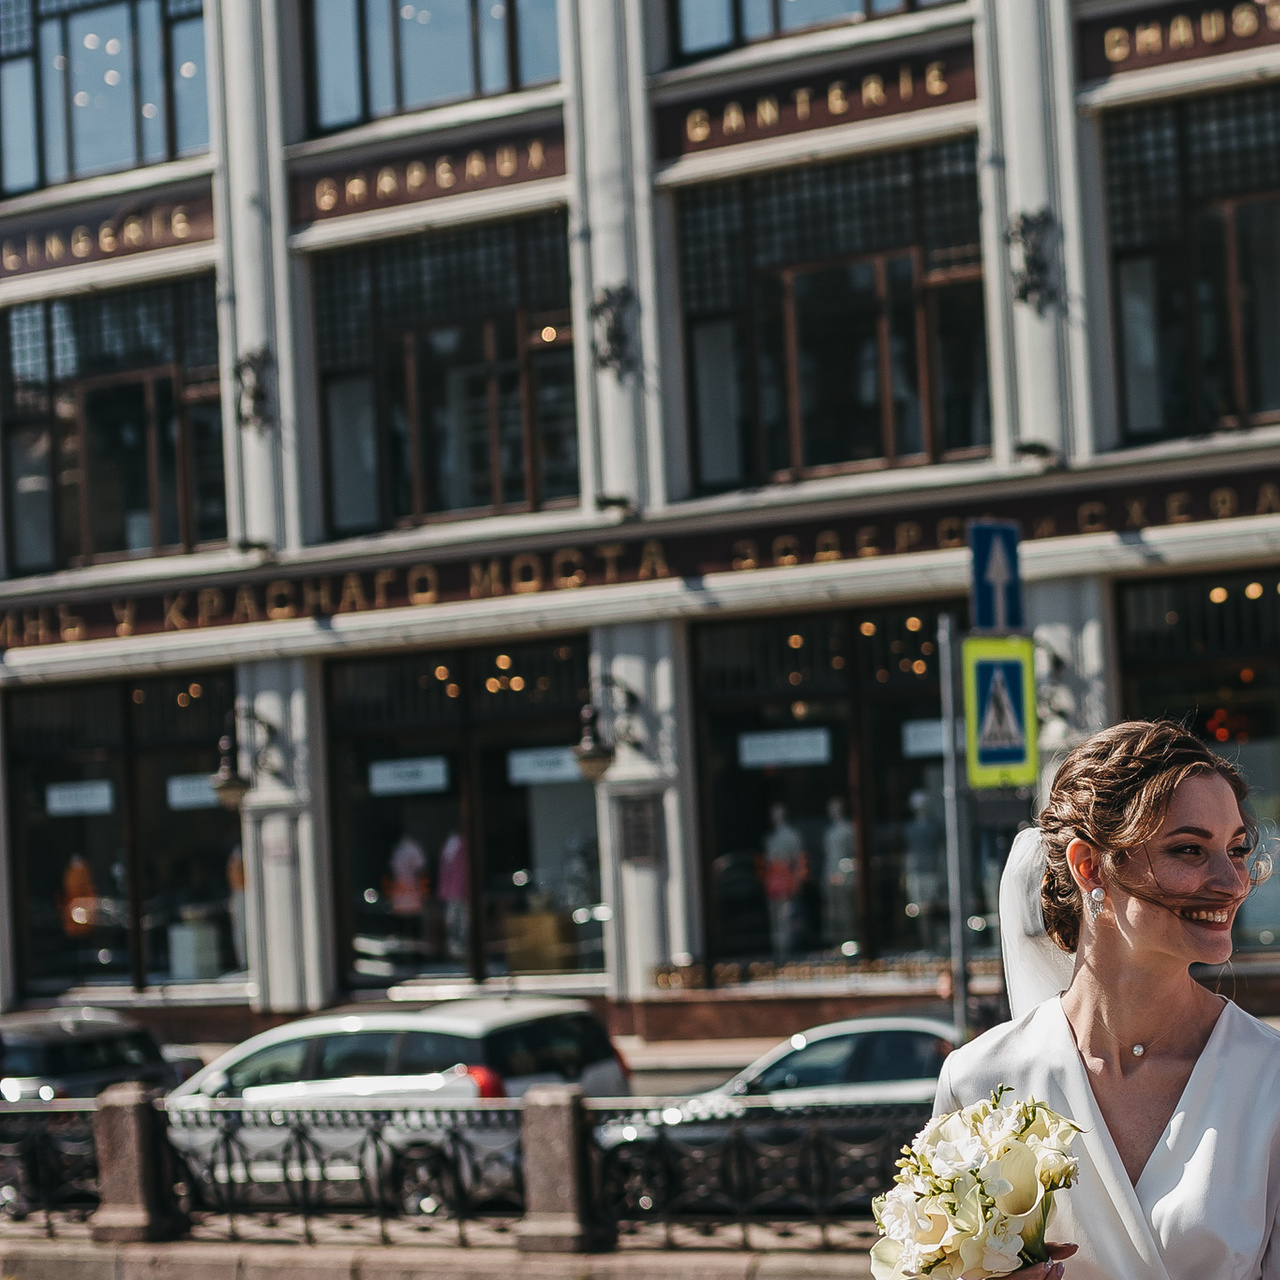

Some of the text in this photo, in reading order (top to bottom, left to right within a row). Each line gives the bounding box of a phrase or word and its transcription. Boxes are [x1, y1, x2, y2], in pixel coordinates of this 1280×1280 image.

[686, 60, 949, 142] GANTERIE
[163, 563, 438, 630] КРАСНАГО
[469, 539, 671, 600] МОСТА
[731, 515, 992, 572] ЭСДЕРС
